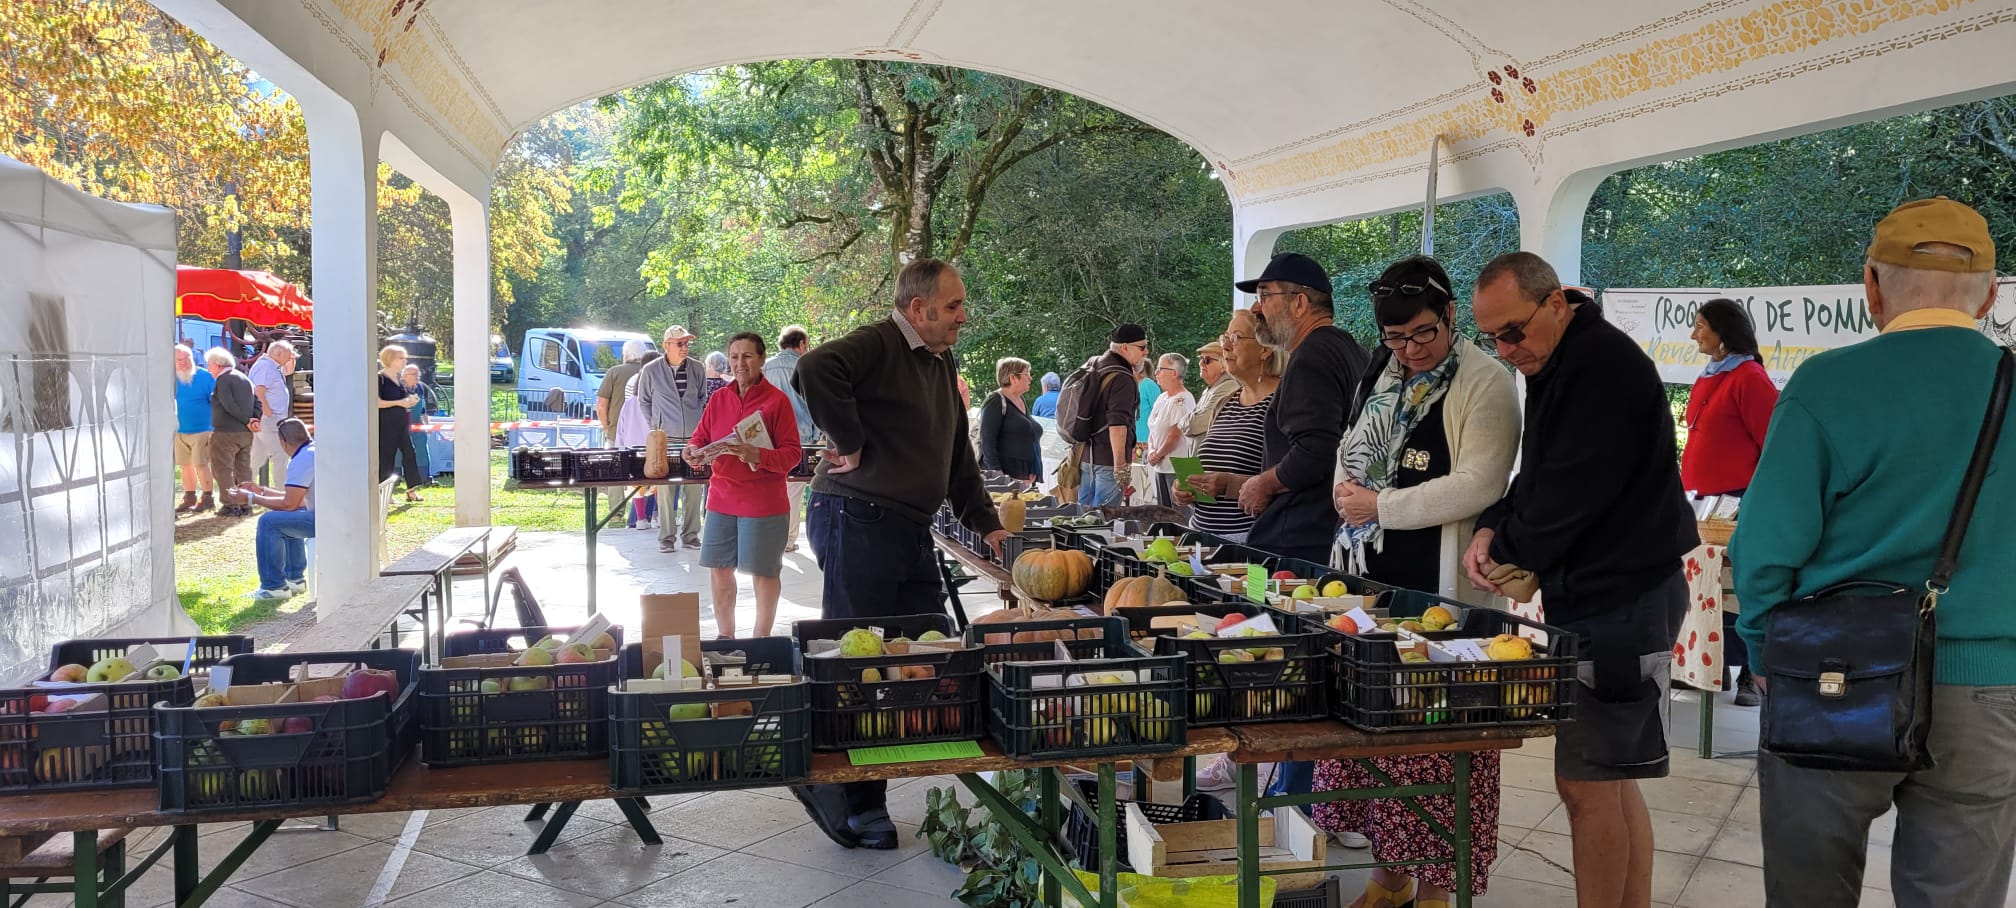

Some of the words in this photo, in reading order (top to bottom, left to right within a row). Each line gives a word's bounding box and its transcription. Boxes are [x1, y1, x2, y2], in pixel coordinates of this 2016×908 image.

[1655, 295, 1756, 334] CROQS
[1765, 299, 1794, 333] DE
[1803, 296, 1874, 335] POMM
